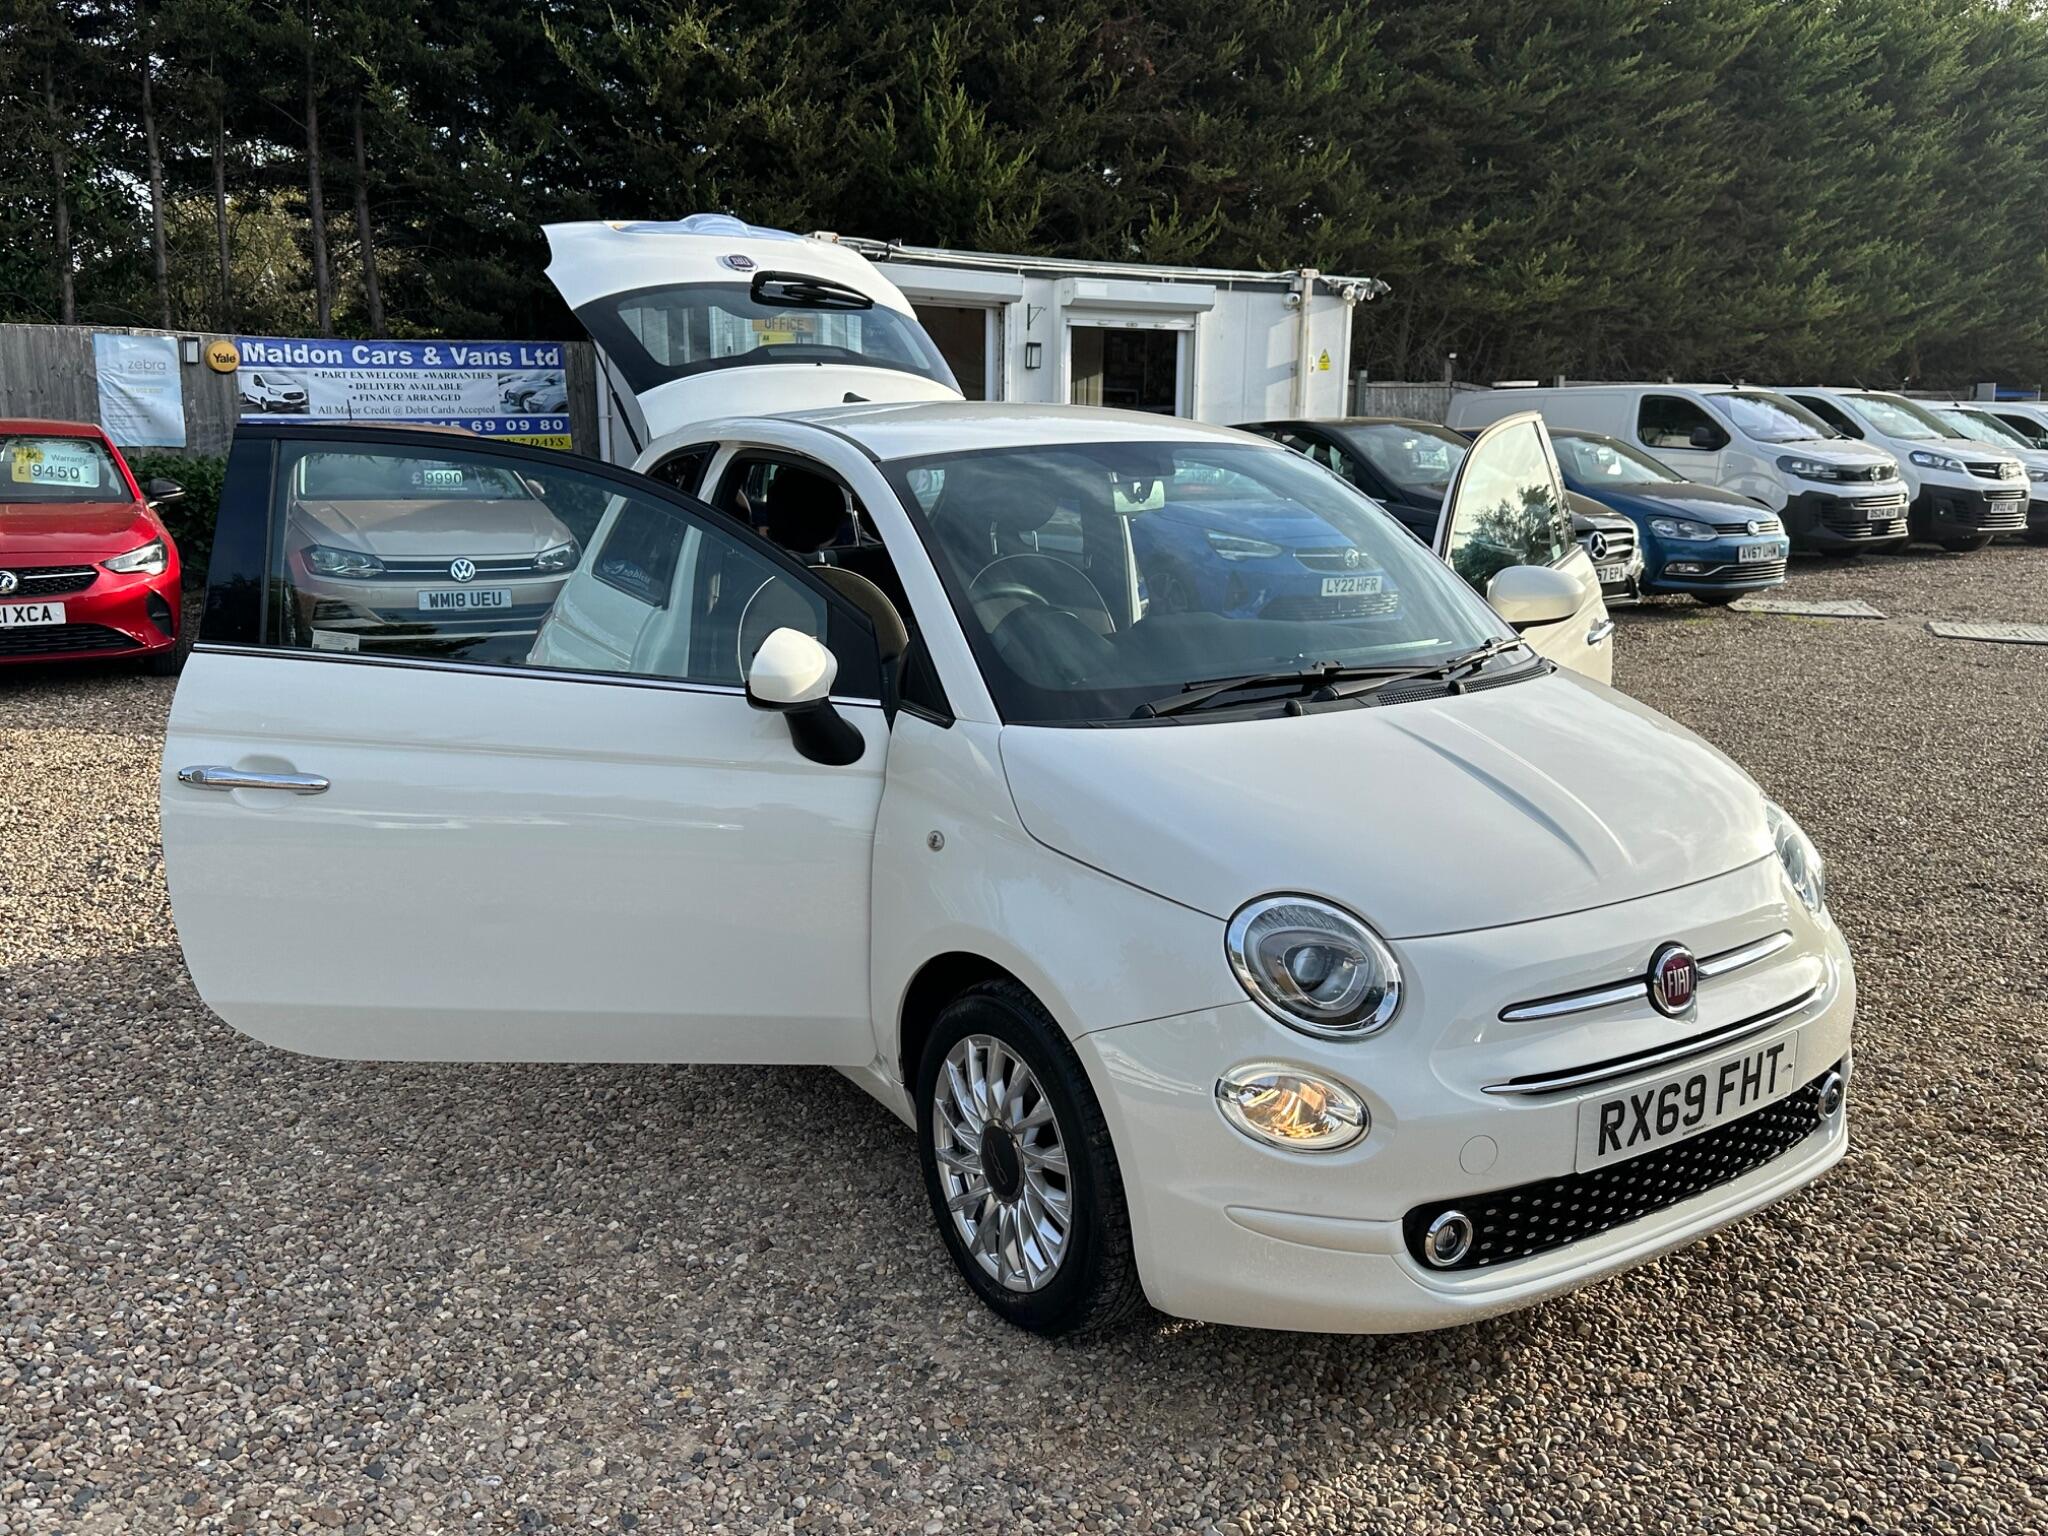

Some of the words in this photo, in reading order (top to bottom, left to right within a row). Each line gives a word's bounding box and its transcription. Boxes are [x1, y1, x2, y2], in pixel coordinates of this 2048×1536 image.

[213, 353, 236, 363] Yale
[241, 342, 343, 364] Maldon
[352, 345, 414, 365] Cars
[423, 346, 442, 365] &
[450, 347, 513, 366] Vans
[520, 347, 560, 366] Ltd
[128, 359, 167, 370] zebra
[321, 371, 347, 379] PART
[350, 371, 364, 379] EX
[366, 371, 419, 380] WELCOME
[428, 372, 493, 380] WARRANTIES
[355, 382, 405, 391] DELIVERY
[409, 383, 463, 391] AVAILABLE
[318, 405, 332, 414] All
[335, 406, 361, 415] Maor
[363, 406, 390, 414] Credit
[405, 406, 429, 414] Debit
[431, 406, 455, 414] Cards
[457, 406, 496, 416] Accepted
[471, 420, 496, 431] 69
[506, 419, 530, 431] 09
[540, 419, 563, 430] 80
[530, 437, 565, 447] DAYS
[51, 454, 88, 464] Warranty
[32, 464, 80, 479] 9450
[425, 472, 461, 484] 9990
[1609, 567, 1624, 580] EPA
[1326, 579, 1355, 593] LY22
[1356, 577, 1378, 592] HFR
[428, 593, 466, 608] WM18
[470, 591, 502, 607] UEU
[13, 605, 52, 623] XCA
[1666, 966, 1690, 998] FIAT
[1597, 1074, 1707, 1156] RX69
[1716, 1042, 1785, 1116] FHT
